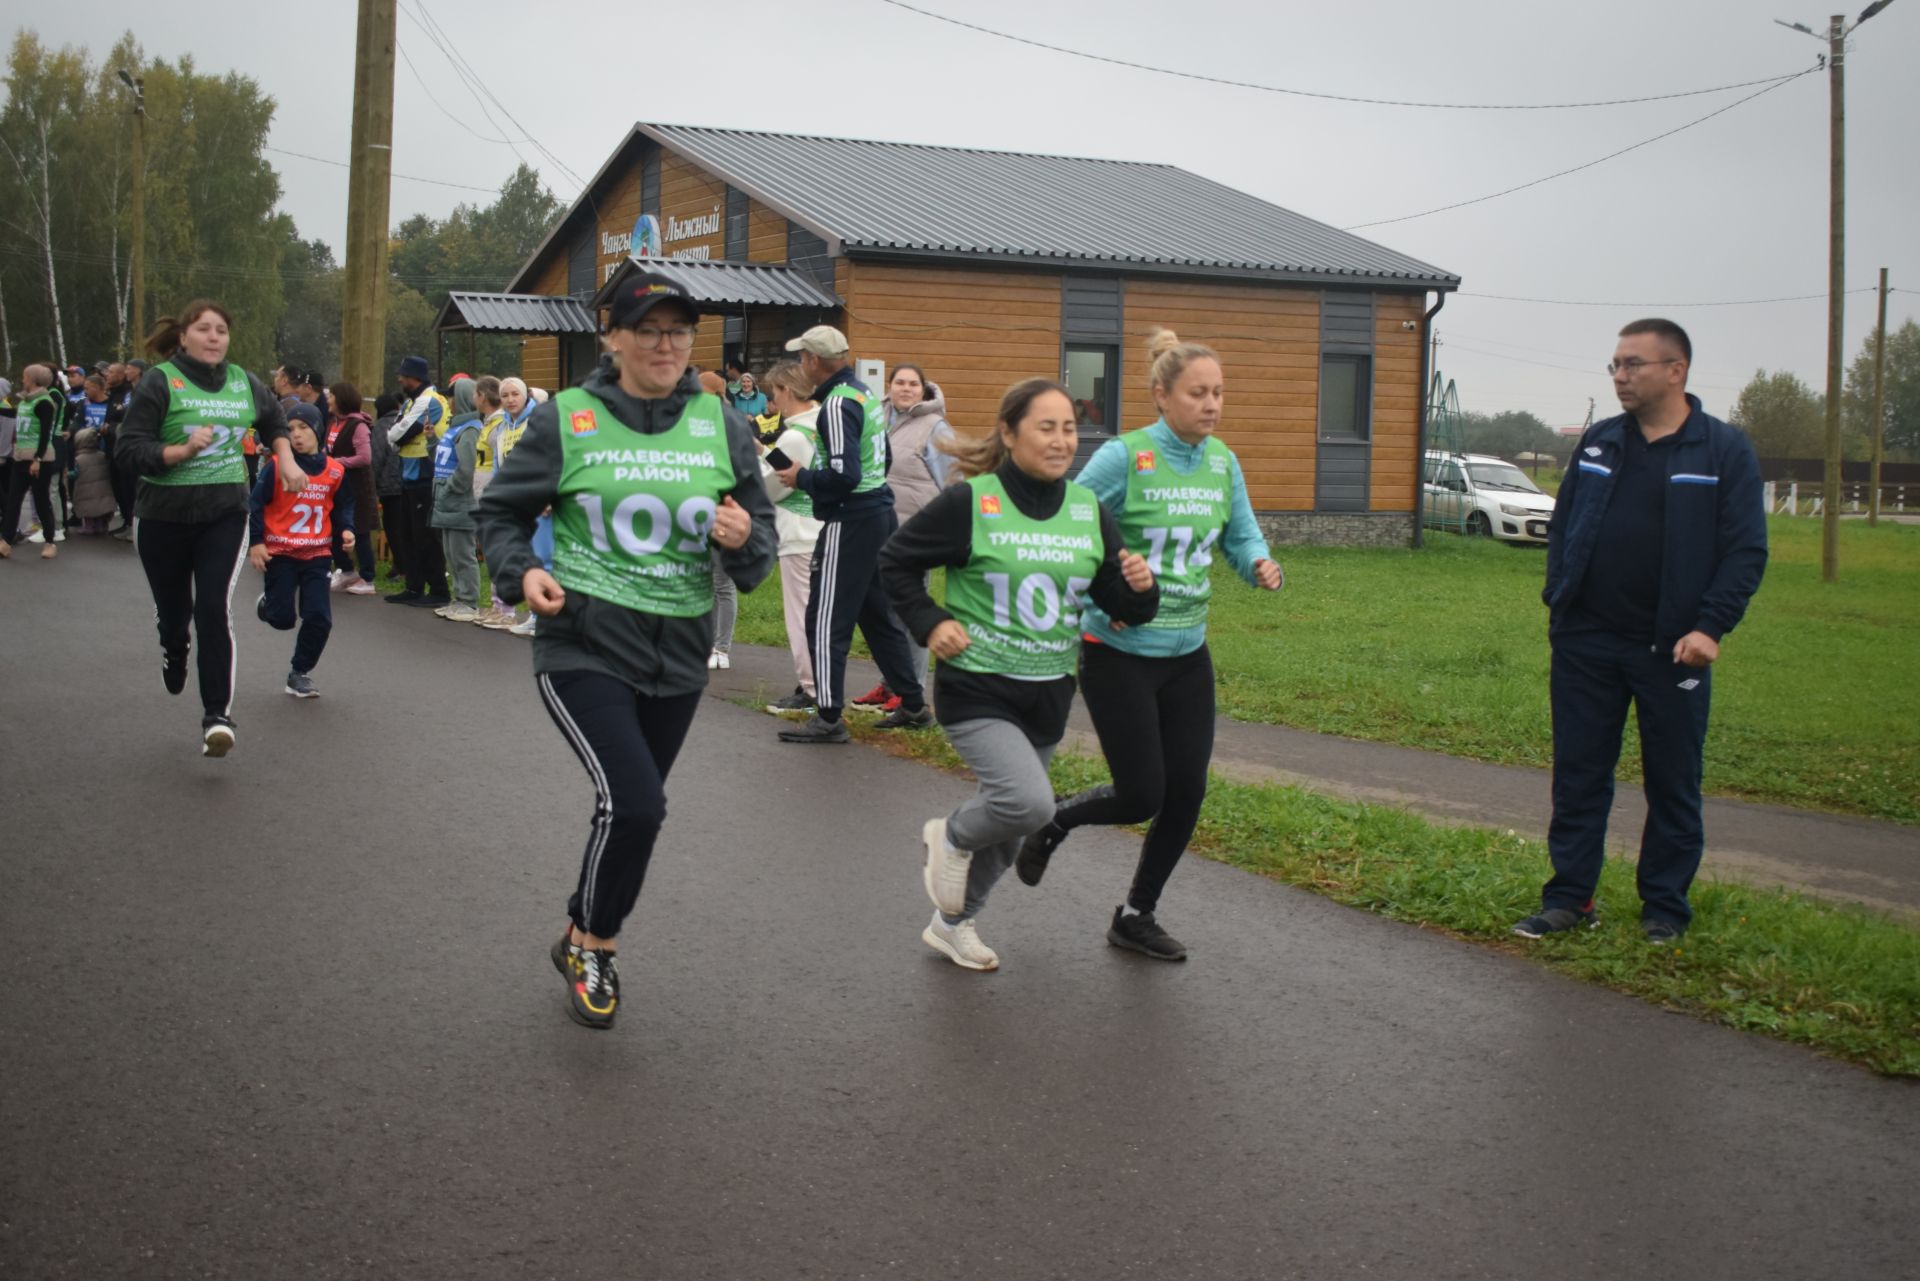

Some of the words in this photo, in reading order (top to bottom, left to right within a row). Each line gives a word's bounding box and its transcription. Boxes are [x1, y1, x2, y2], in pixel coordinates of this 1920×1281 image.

[664, 204, 720, 242] Лыжный
[181, 400, 249, 410] ТУКАЕВСКИЙ
[200, 409, 240, 419] РАЙОН
[583, 449, 716, 468] ТУКАЕВСКИЙ
[614, 465, 690, 482] РАЙОН
[1142, 487, 1224, 502] ТУКАЕВСКИЙ
[1167, 501, 1212, 516] РАЙОН
[288, 503, 324, 534] 21
[989, 532, 1093, 550] ТУКАЕВСКИЙ
[1016, 546, 1074, 563] РАЙОН
[984, 571, 1091, 632] 105
